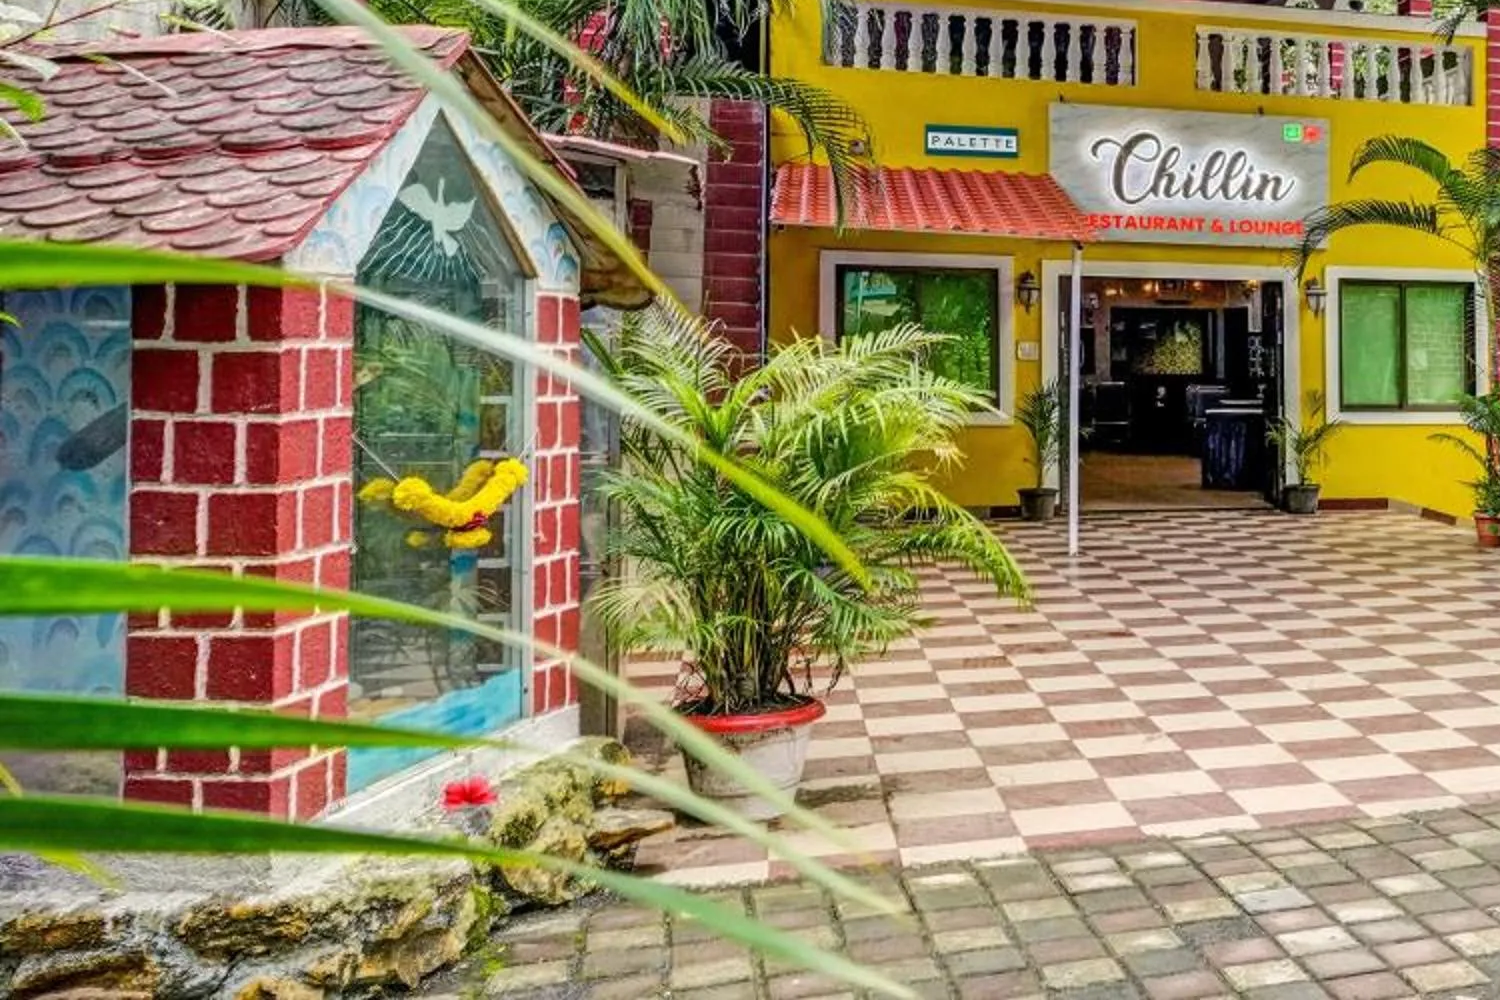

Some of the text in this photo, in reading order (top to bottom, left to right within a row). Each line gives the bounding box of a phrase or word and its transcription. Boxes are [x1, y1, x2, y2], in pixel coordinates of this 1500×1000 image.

[931, 135, 1014, 149] PALETTE
[1091, 132, 1295, 204] Chillin
[1086, 214, 1305, 236] ESTAURANT & LOUNGE
